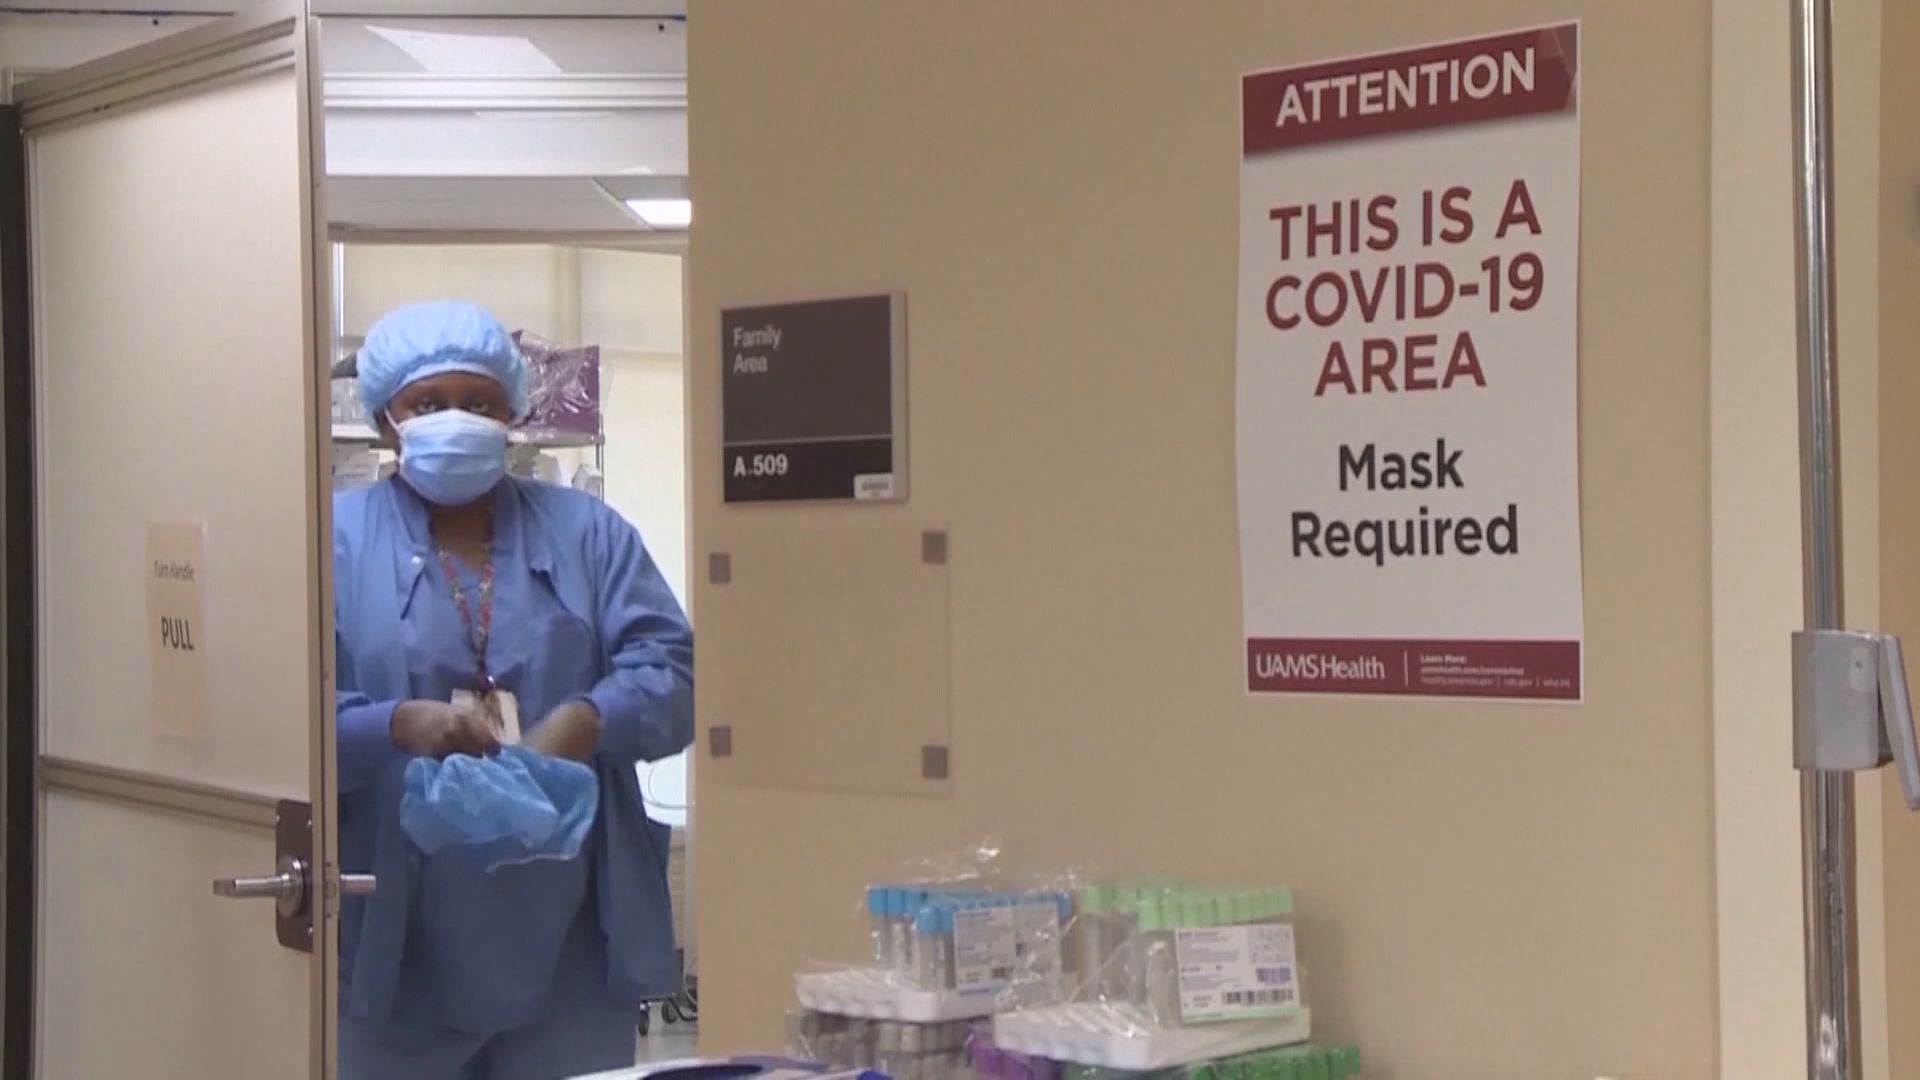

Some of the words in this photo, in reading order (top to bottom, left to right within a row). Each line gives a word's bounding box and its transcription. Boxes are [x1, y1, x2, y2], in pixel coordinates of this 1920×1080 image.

[1276, 47, 1535, 128] ATTENTION
[1269, 195, 1399, 261] THIS
[1422, 186, 1475, 247] IS
[1495, 179, 1542, 240] A
[1265, 252, 1544, 331] COVID-19
[733, 325, 782, 350] Family
[733, 354, 768, 374] Area
[1314, 331, 1487, 397] AREA
[1338, 438, 1464, 491] Mask
[1291, 504, 1519, 567] Required
[161, 616, 194, 650] PULL
[1420, 653, 1443, 663] Learn
